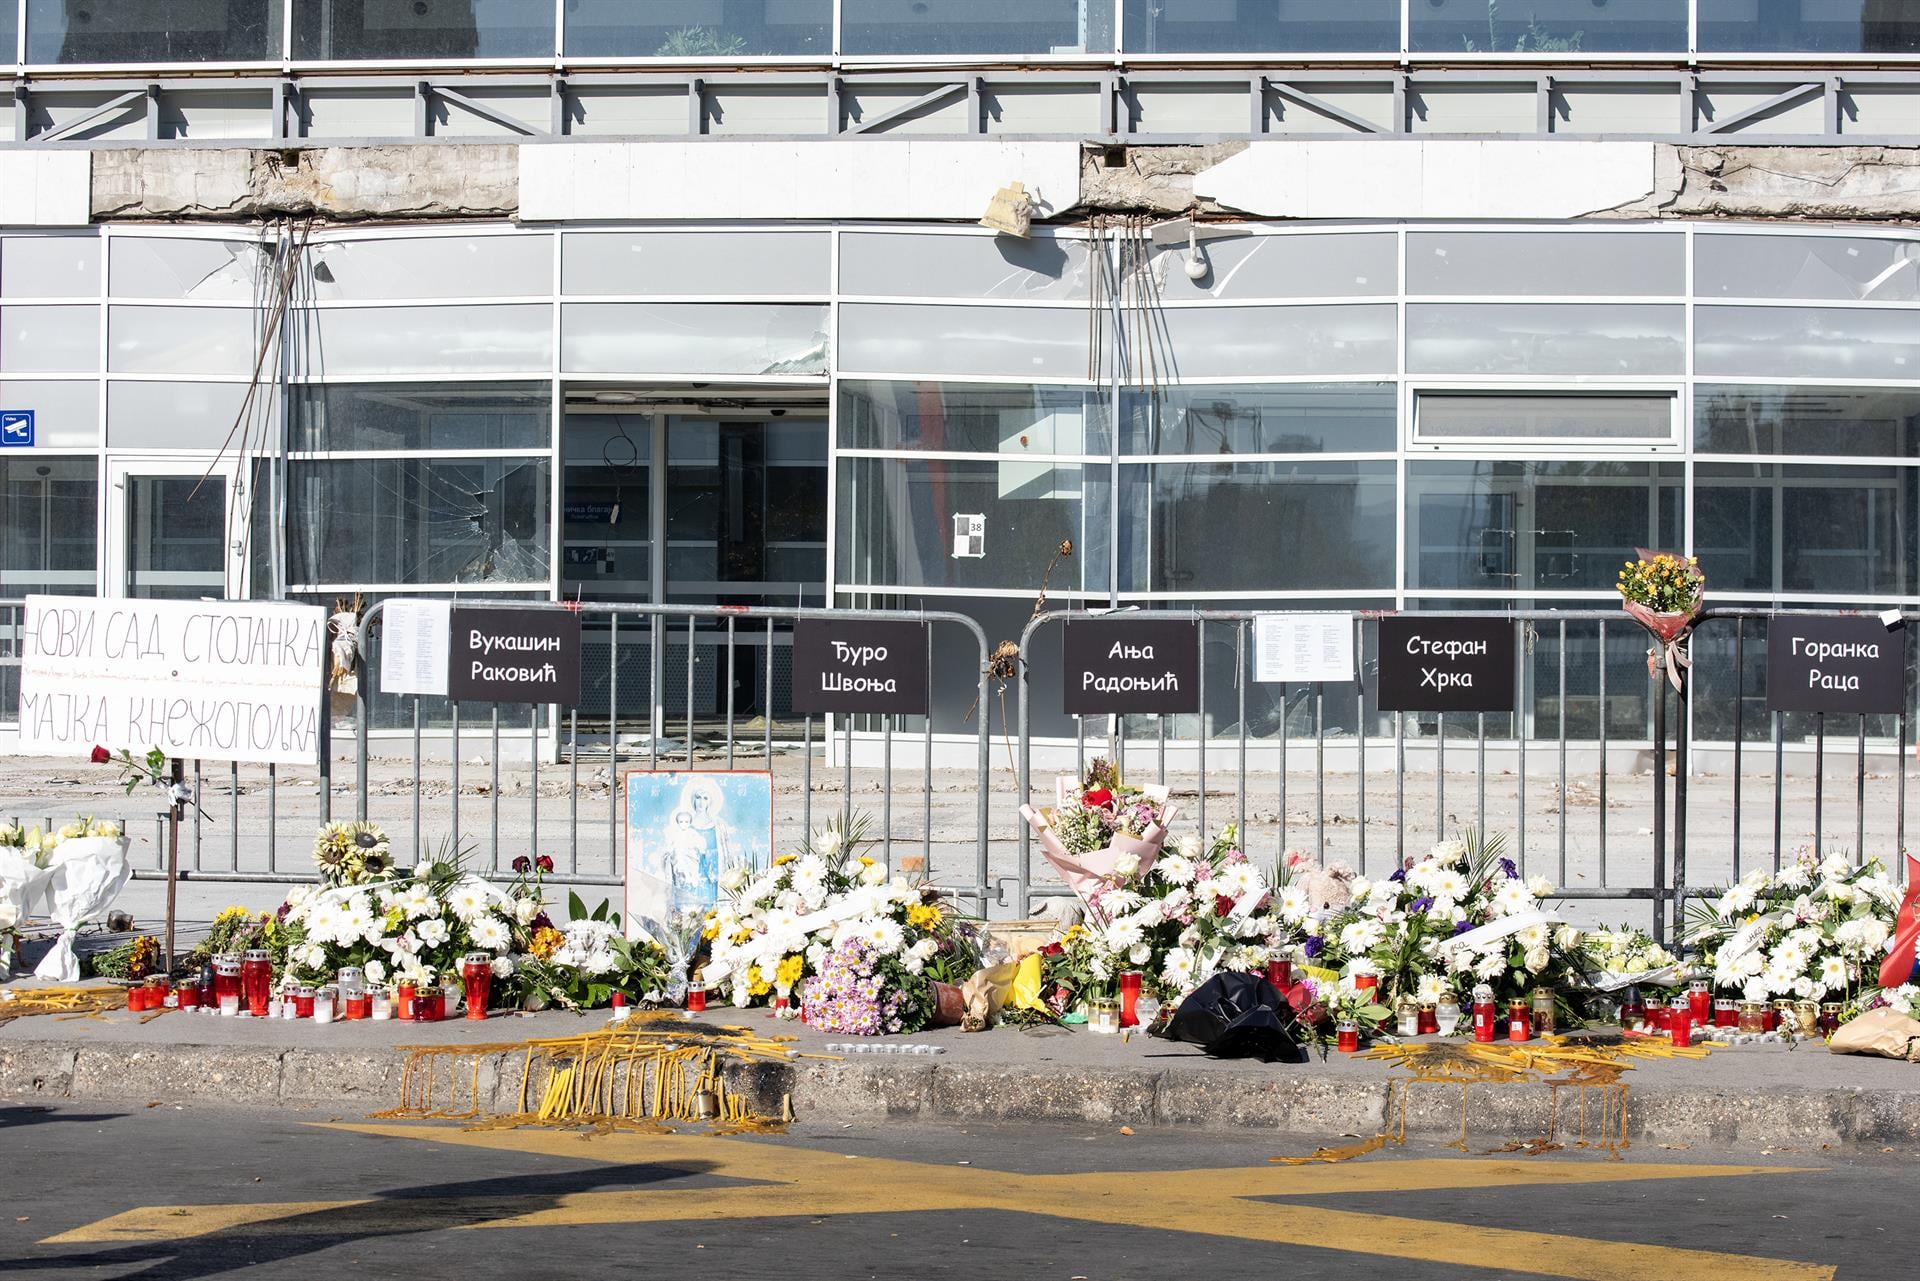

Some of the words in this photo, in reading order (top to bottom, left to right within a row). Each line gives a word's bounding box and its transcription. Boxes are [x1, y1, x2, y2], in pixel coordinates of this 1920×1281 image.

[970, 523, 982, 532] 38
[24, 607, 95, 657] НОВИ
[105, 611, 165, 661] САД
[183, 614, 320, 668] СТОЈАНКА
[469, 629, 560, 655] Вукашин
[1108, 640, 1154, 659] Ања
[1406, 635, 1487, 661] Стефан
[1791, 637, 1880, 662] Горанка
[830, 640, 888, 666] Ђуро
[471, 661, 557, 683] Раковић
[822, 672, 896, 693] Швоња
[1083, 671, 1178, 693] Радоњић
[1420, 667, 1473, 693] Хрка
[1809, 668, 1859, 691] Раца
[18, 692, 109, 743] МАЈКА
